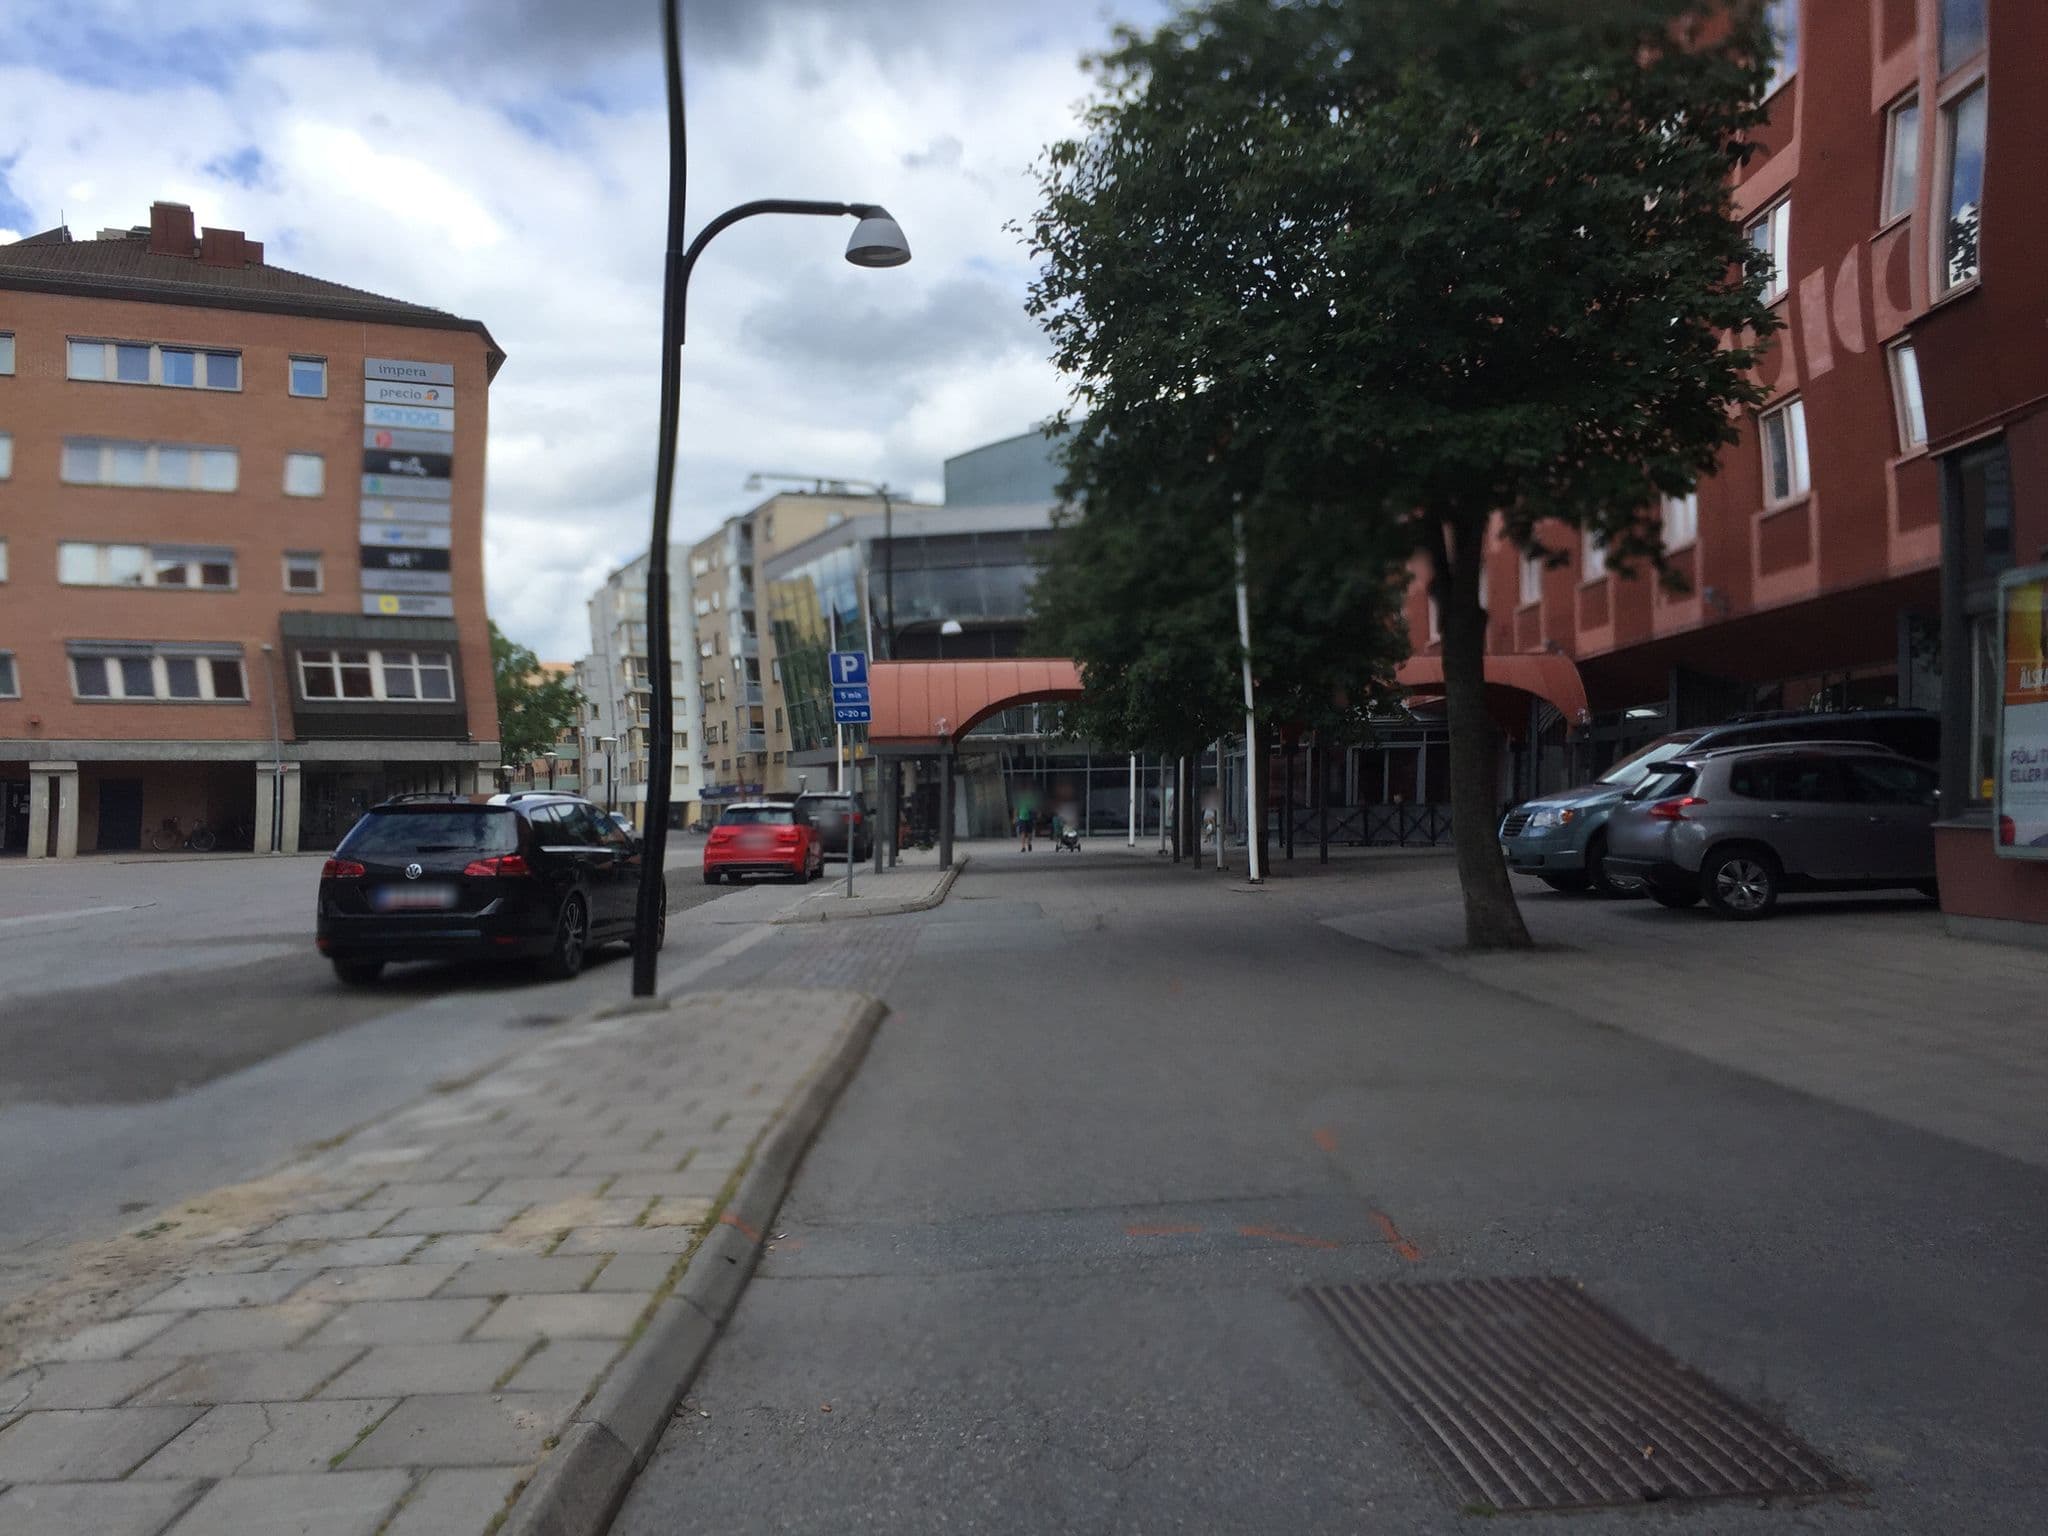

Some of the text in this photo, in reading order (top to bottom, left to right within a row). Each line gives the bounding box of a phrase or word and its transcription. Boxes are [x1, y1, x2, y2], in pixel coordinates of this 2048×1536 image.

[378, 363, 427, 378] impera
[379, 388, 422, 400] precio
[841, 656, 858, 682] P
[848, 691, 862, 699] min
[838, 710, 859, 718] 0-20
